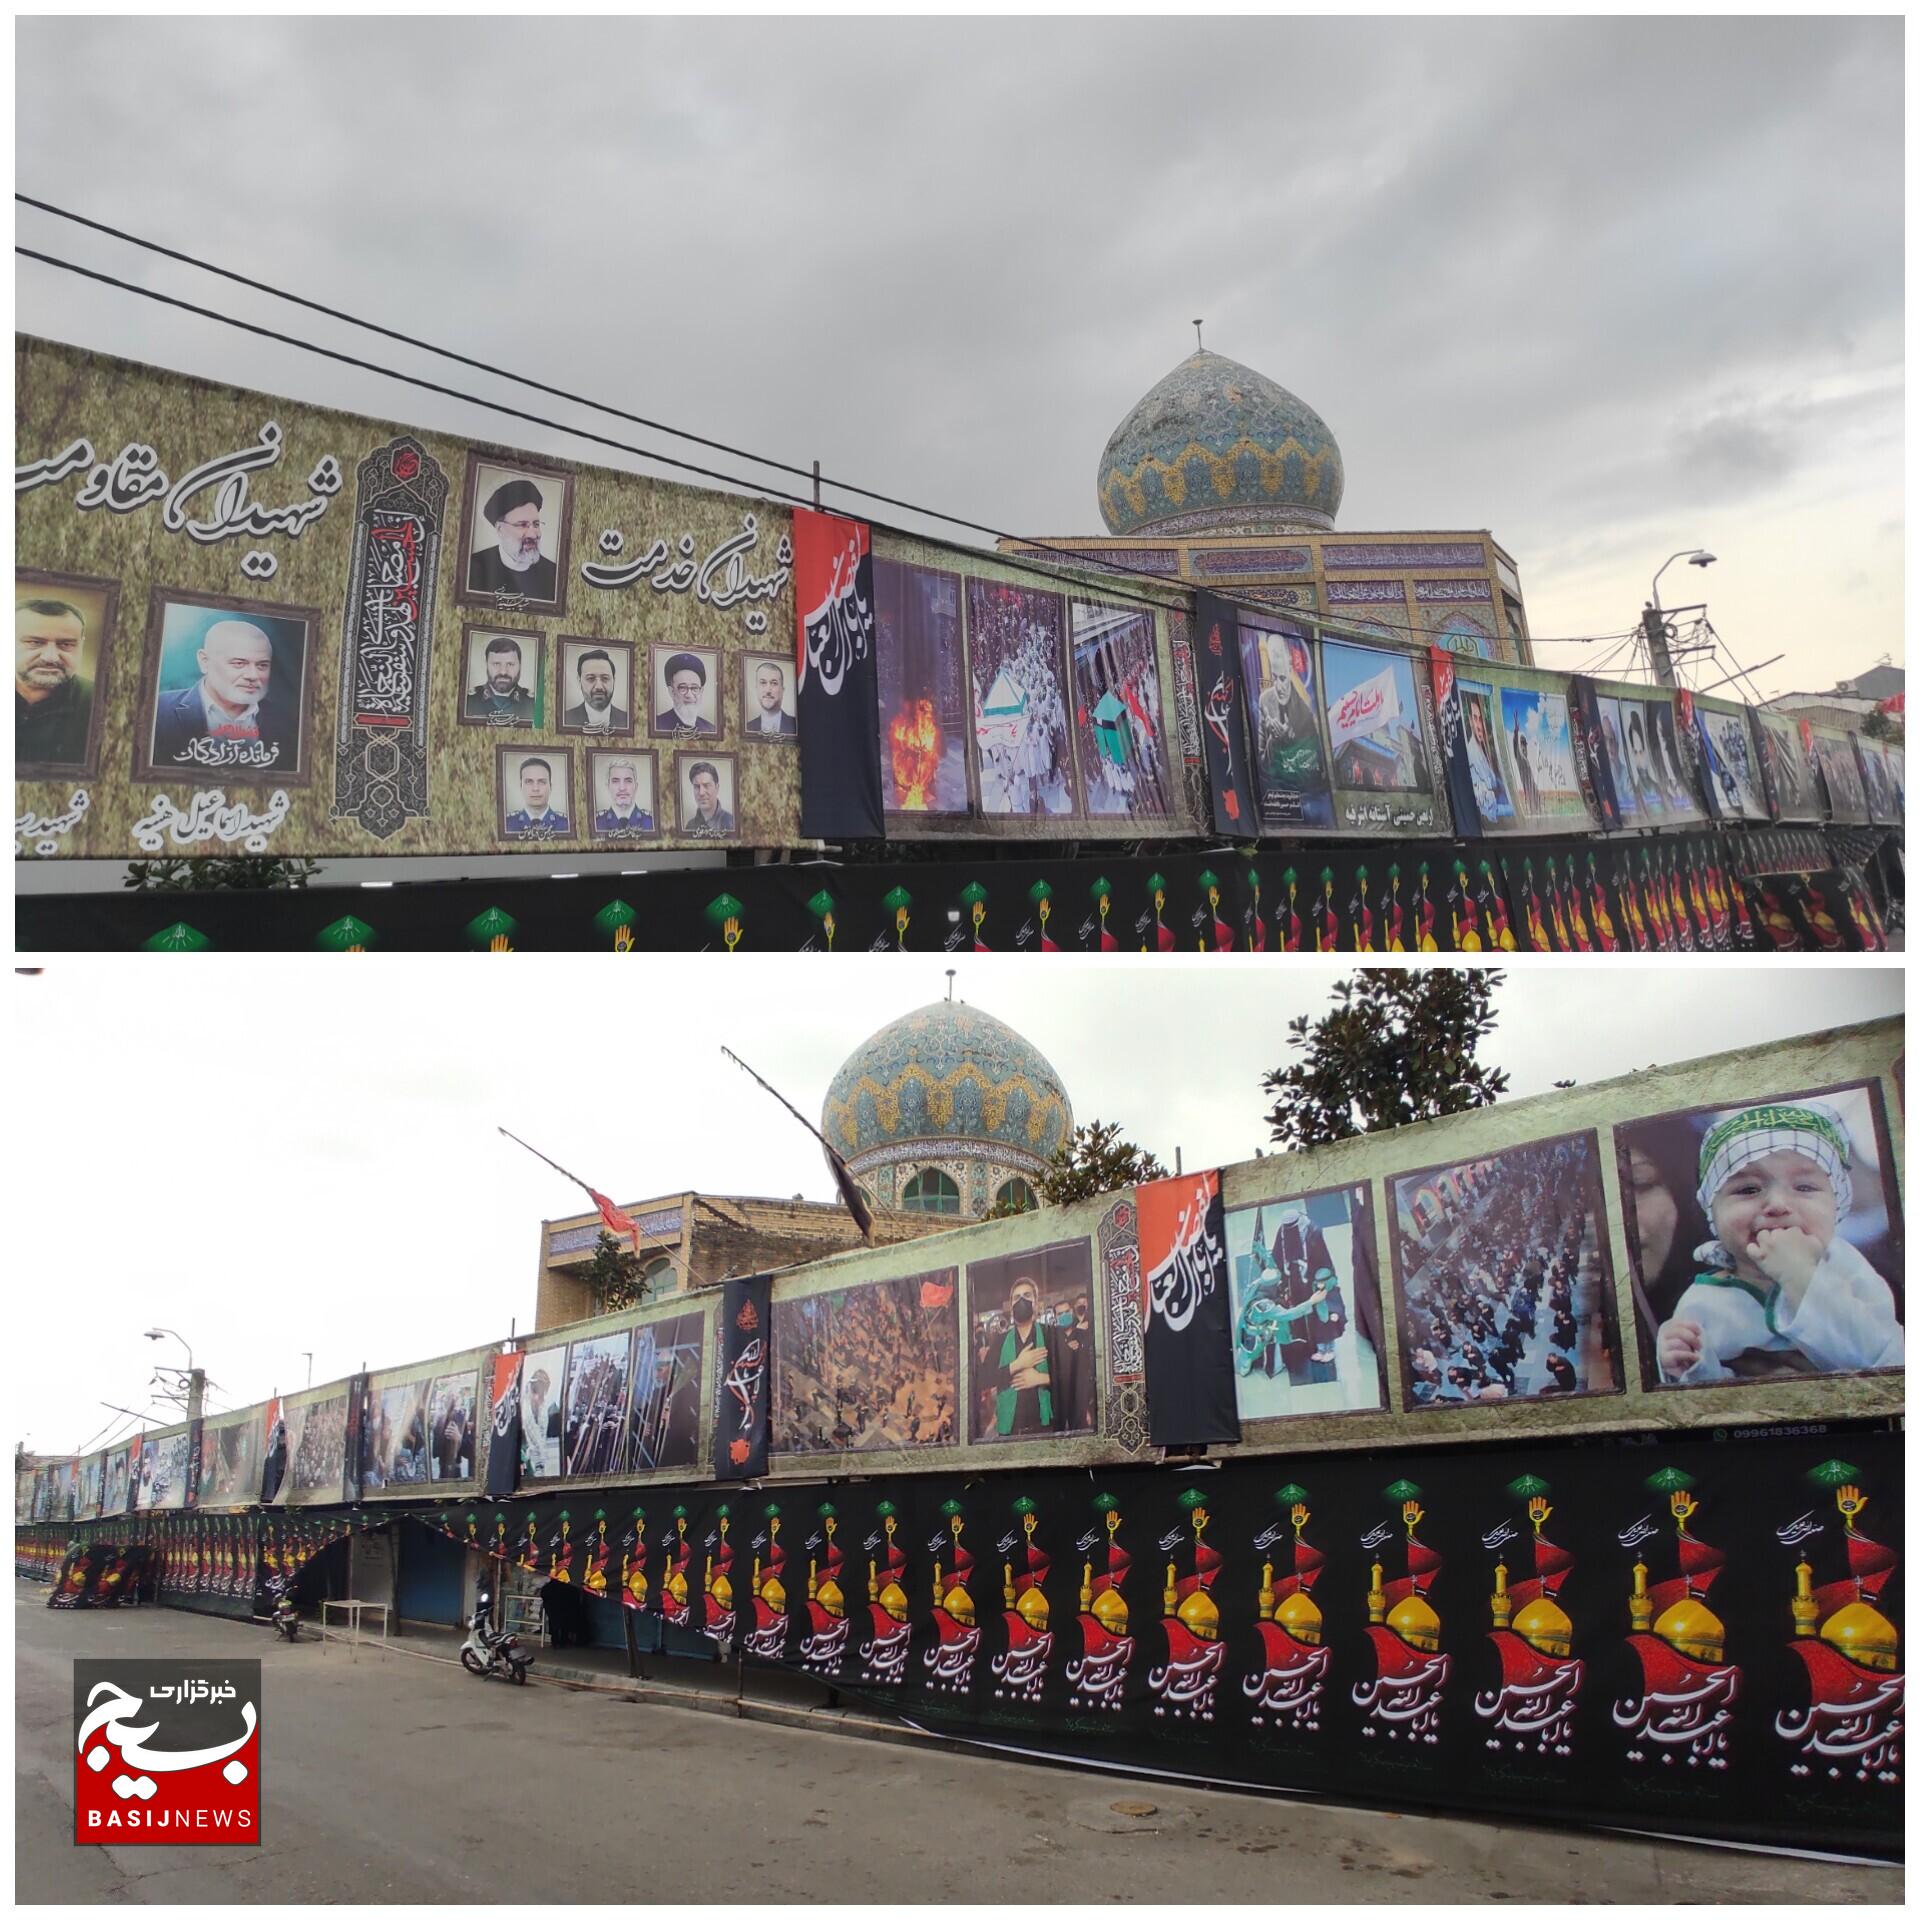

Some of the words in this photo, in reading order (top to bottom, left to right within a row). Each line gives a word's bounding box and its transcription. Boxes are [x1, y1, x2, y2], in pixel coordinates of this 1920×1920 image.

[163, 420, 343, 580] شهیدان
[581, 528, 699, 594] خدمت
[696, 512, 794, 636] شهیدان
[173, 736, 246, 766] آزادگان
[239, 740, 280, 768] فرمانده
[23, 789, 90, 855] شهید
[172, 790, 246, 843] اسماعیل
[238, 790, 290, 852] شهید
[1345, 804, 1369, 826] اشرفیه
[1369, 801, 1391, 821] آستانه
[1393, 807, 1416, 826] حسینی
[1734, 1424, 1828, 1439] 09961836368
